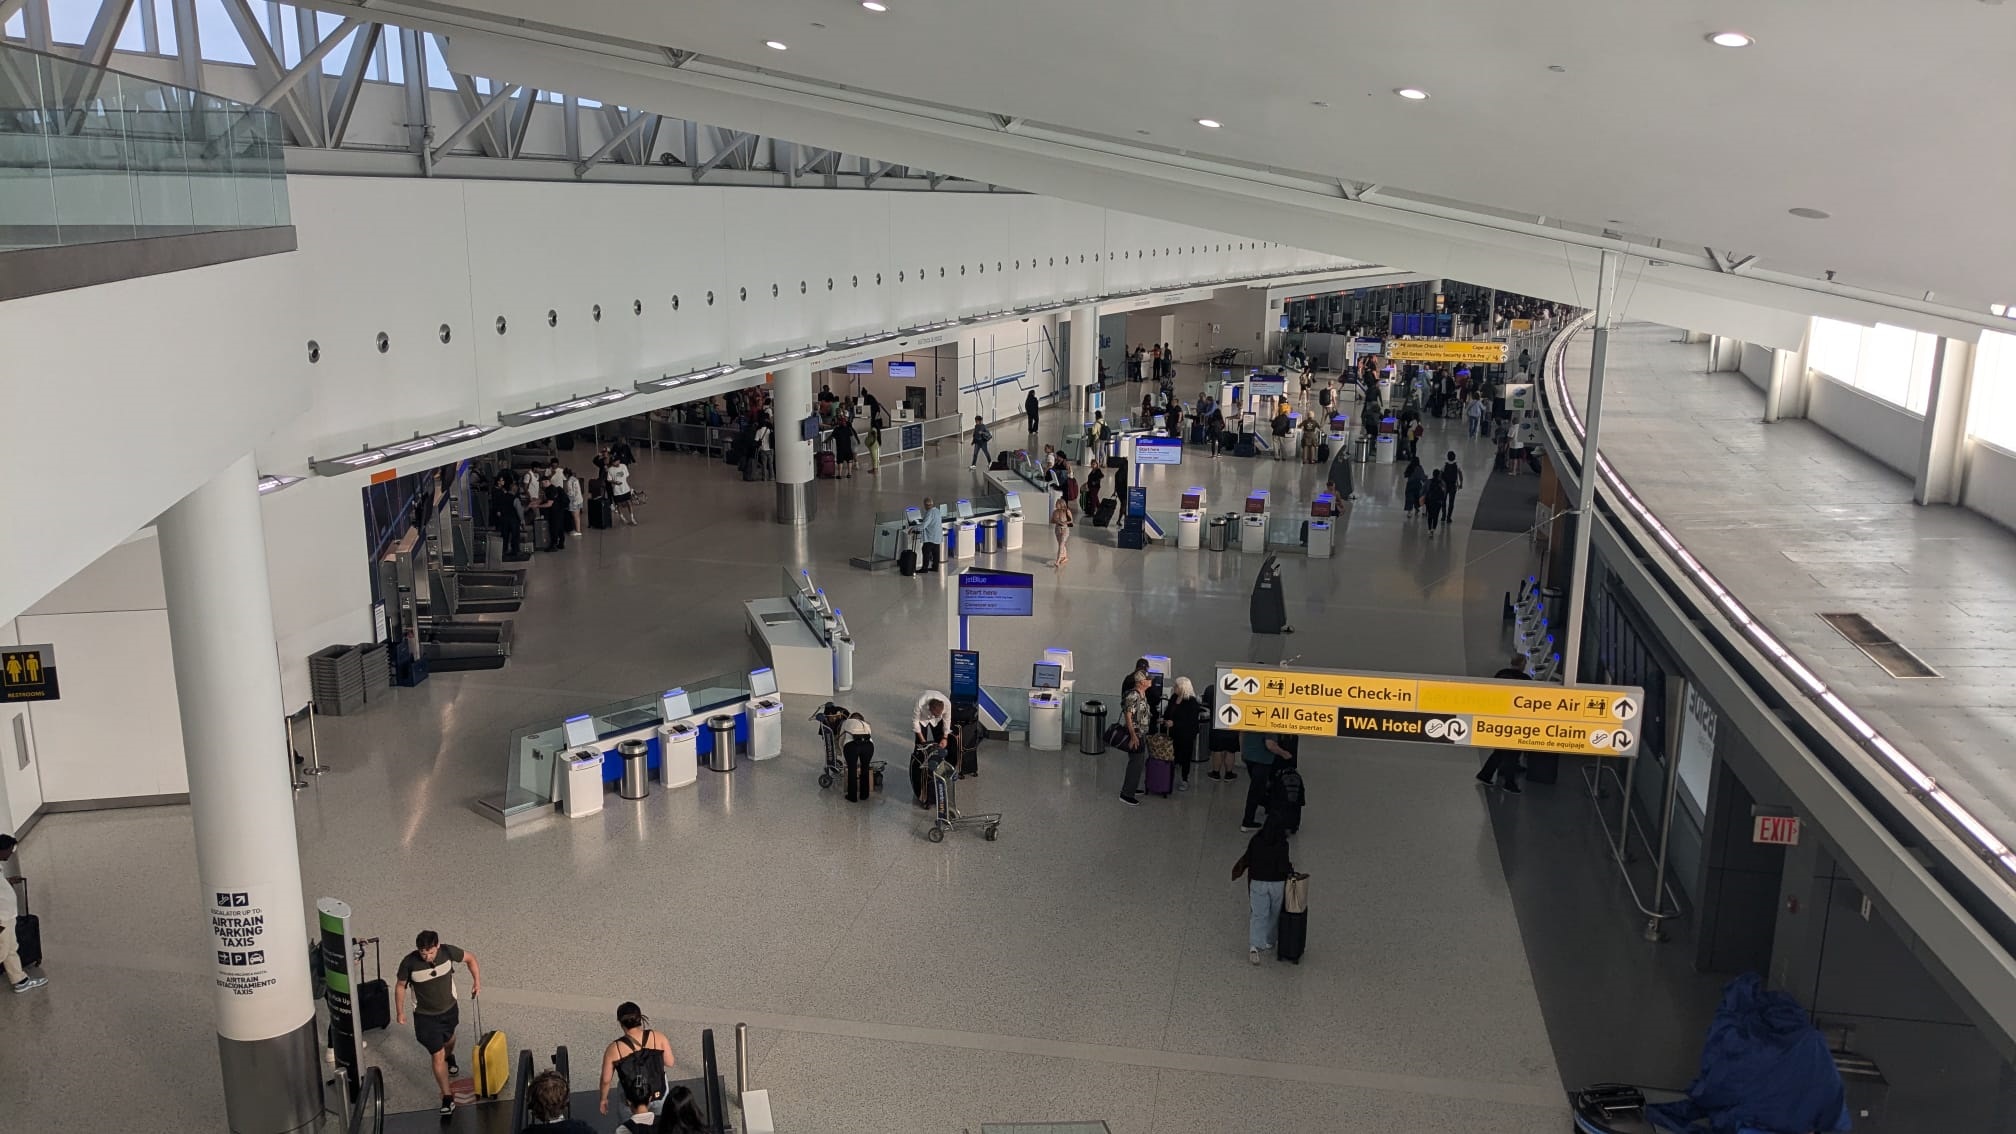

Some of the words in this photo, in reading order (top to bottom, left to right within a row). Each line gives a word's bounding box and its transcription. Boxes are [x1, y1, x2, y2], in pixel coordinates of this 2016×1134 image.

[966, 576, 987, 584] jetBlue
[1288, 682, 1342, 698] JetBlue
[1348, 686, 1412, 702] Check-in
[1513, 696, 1552, 712] Cape
[1556, 698, 1580, 712] Air
[1270, 706, 1289, 720] All
[1294, 708, 1334, 722] Gates
[1344, 716, 1378, 731] TWA
[1382, 718, 1422, 734] Hotel
[1476, 720, 1540, 740] Baggage
[1546, 725, 1586, 740] Claim
[1760, 817, 1796, 842] EXIT
[212, 915, 264, 928] AIRTRAIN
[214, 926, 263, 937] PARKING
[221, 937, 255, 947] TAXIS
[216, 978, 276, 989] ESTACIONAMIENTO
